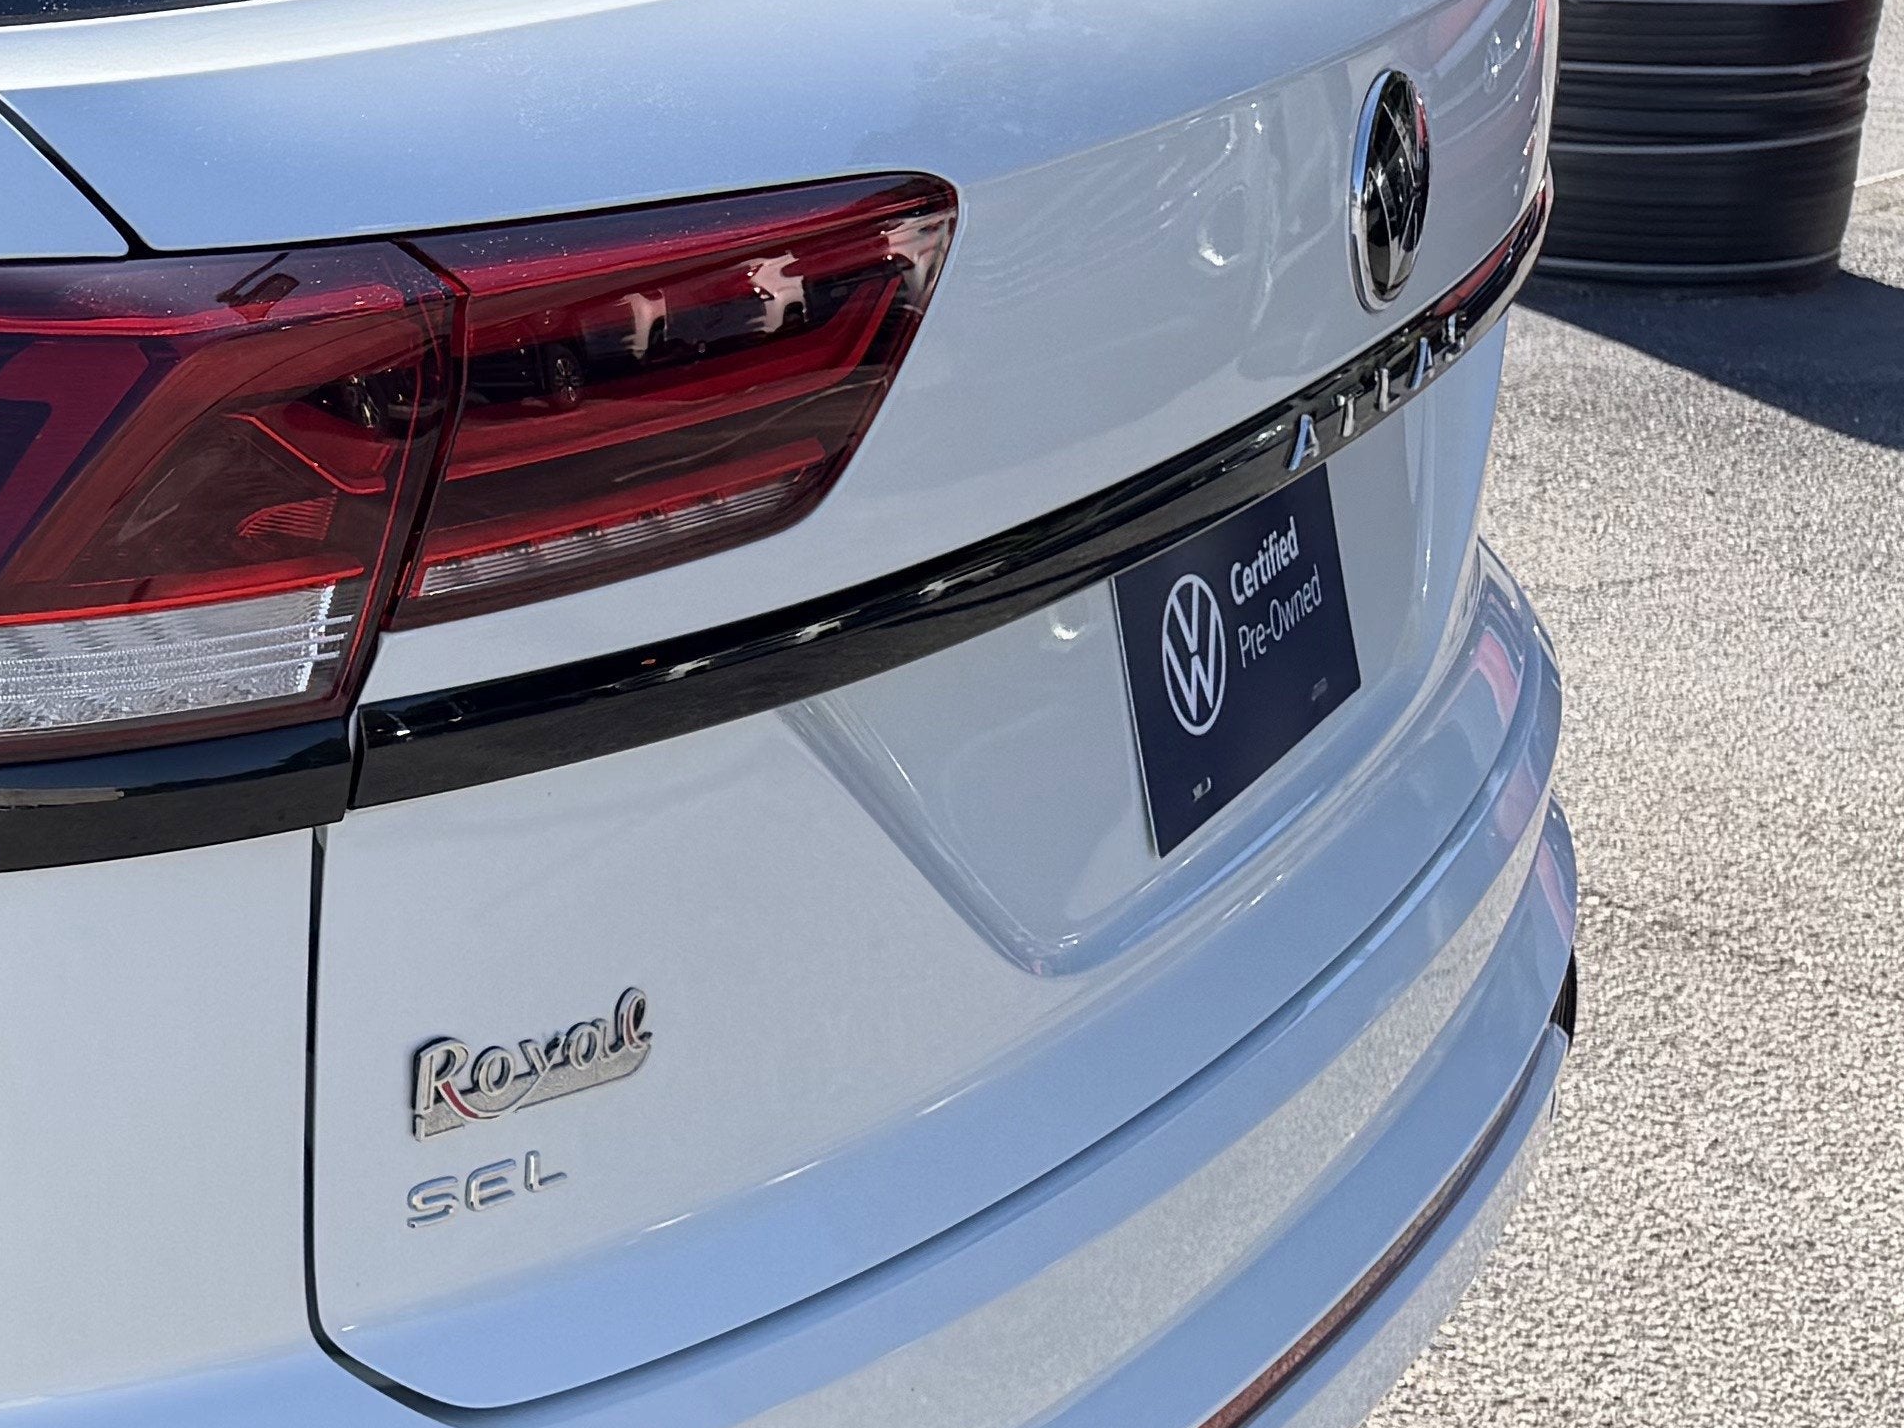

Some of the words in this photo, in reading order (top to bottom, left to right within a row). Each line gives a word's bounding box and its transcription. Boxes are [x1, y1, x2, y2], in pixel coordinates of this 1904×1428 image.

[1286, 311, 1468, 472] ATLAS
[1230, 515, 1300, 606] Certified
[1237, 564, 1323, 669] Pre-Owned
[411, 985, 655, 1132] Royal
[406, 1149, 568, 1230] SEL
